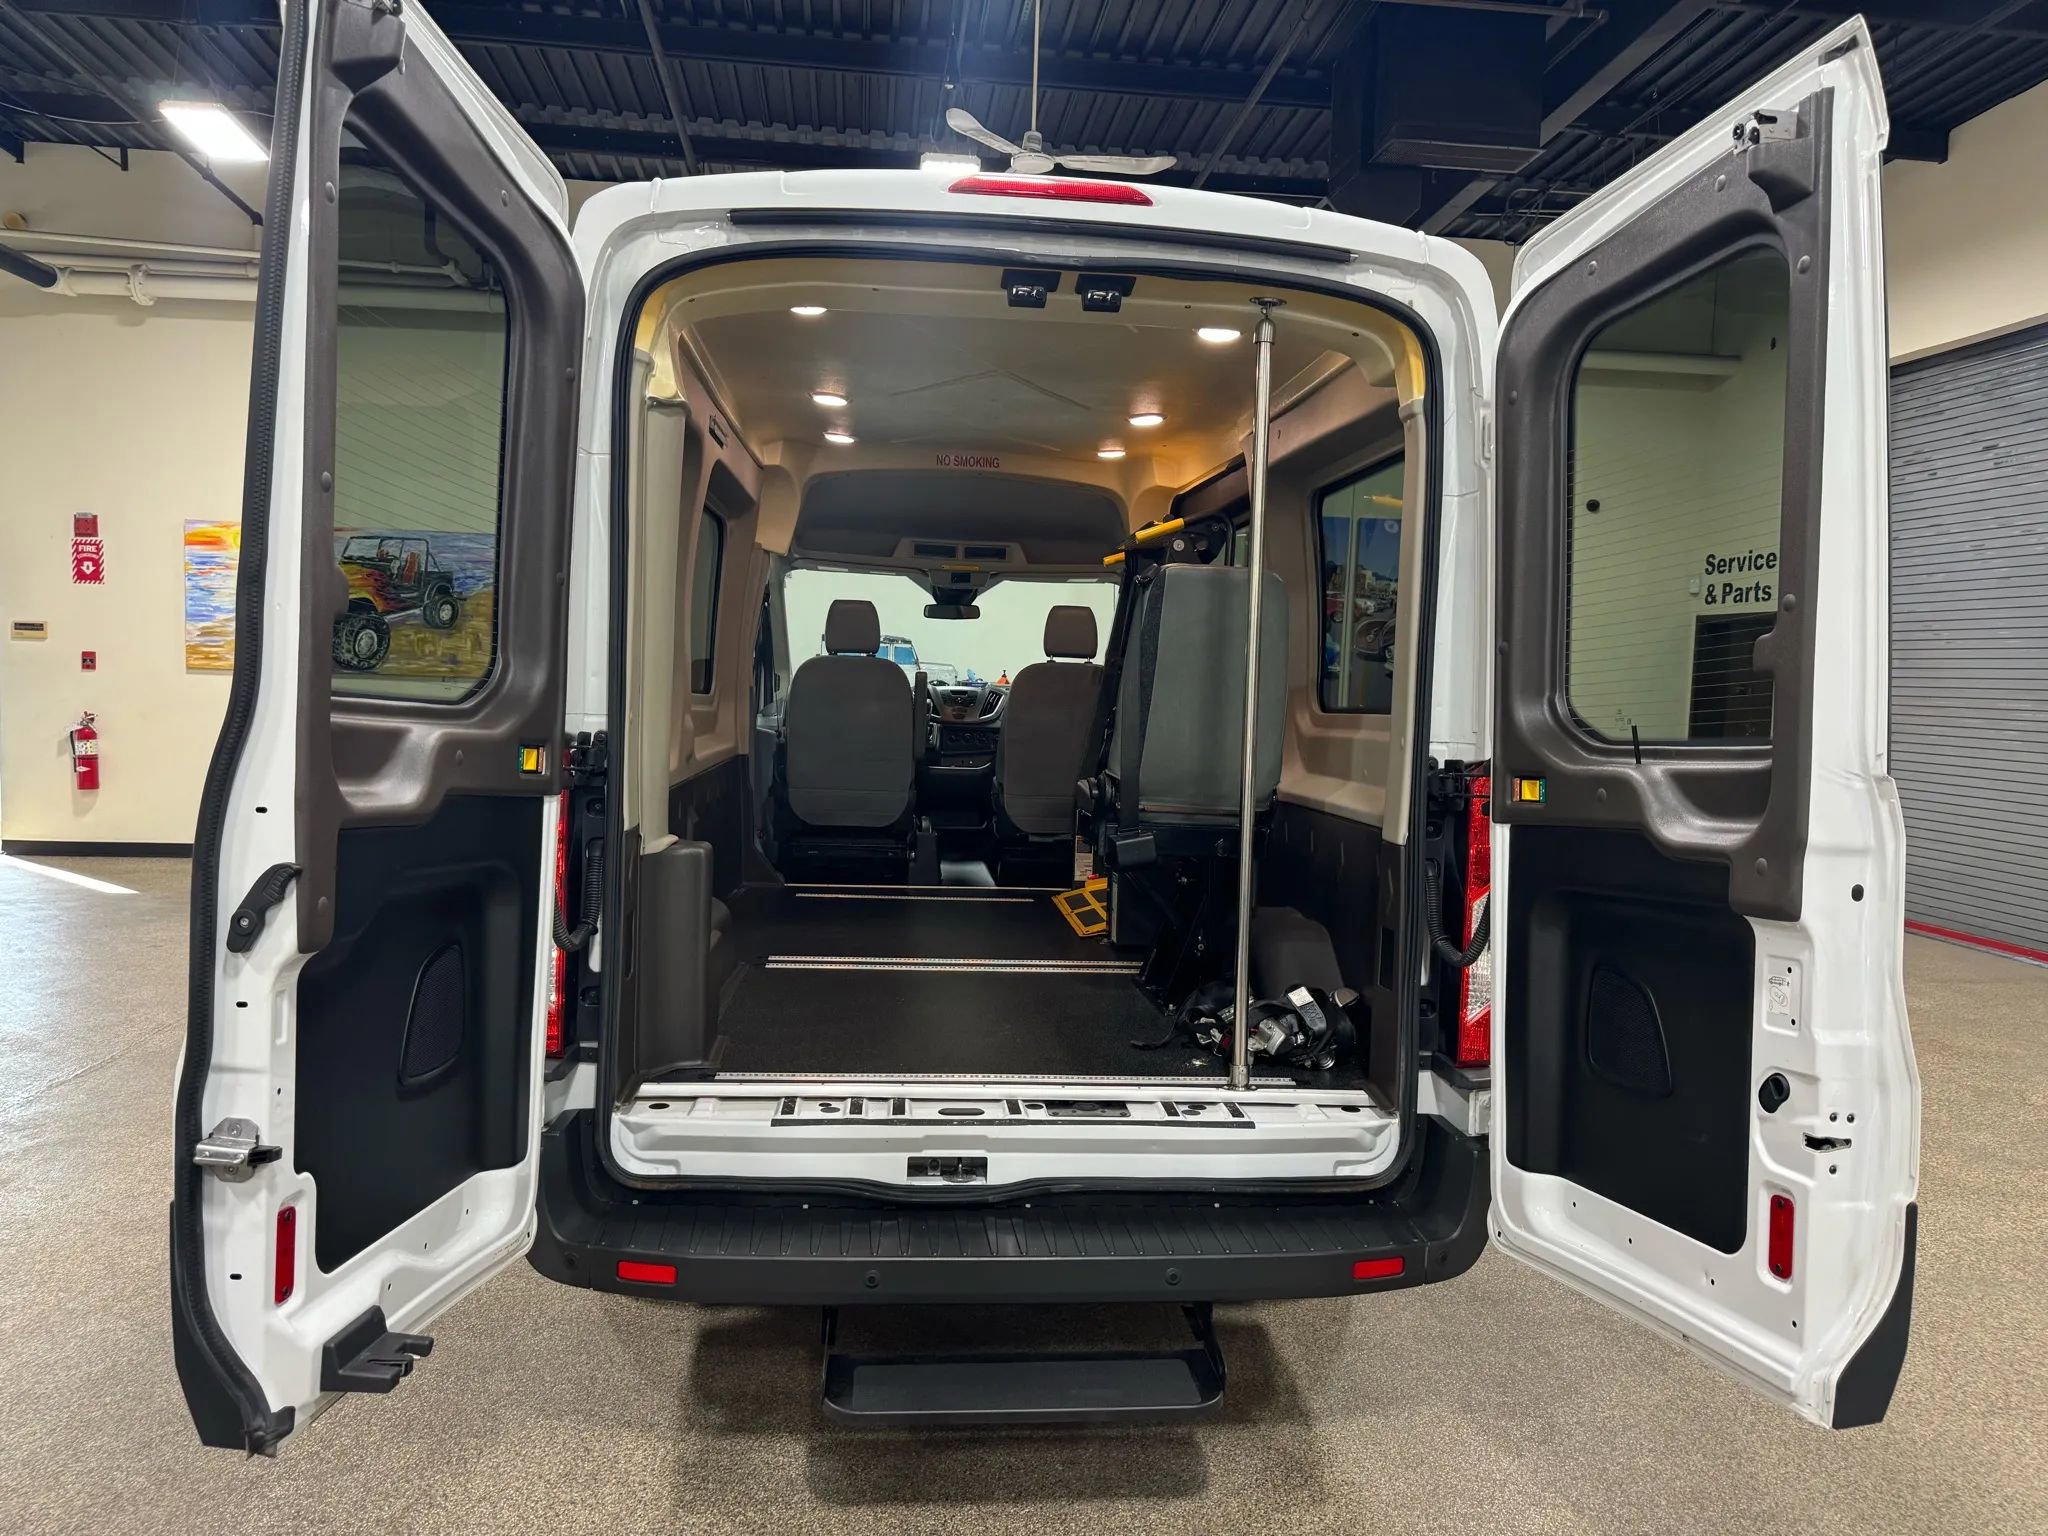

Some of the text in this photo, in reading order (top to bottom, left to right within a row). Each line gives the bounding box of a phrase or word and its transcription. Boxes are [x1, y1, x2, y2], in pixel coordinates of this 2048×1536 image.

[936, 454, 1000, 469] NO SMOKING
[78, 544, 98, 553] FIRE
[1704, 549, 1778, 576] Service
[1704, 580, 1773, 606] & Parts
